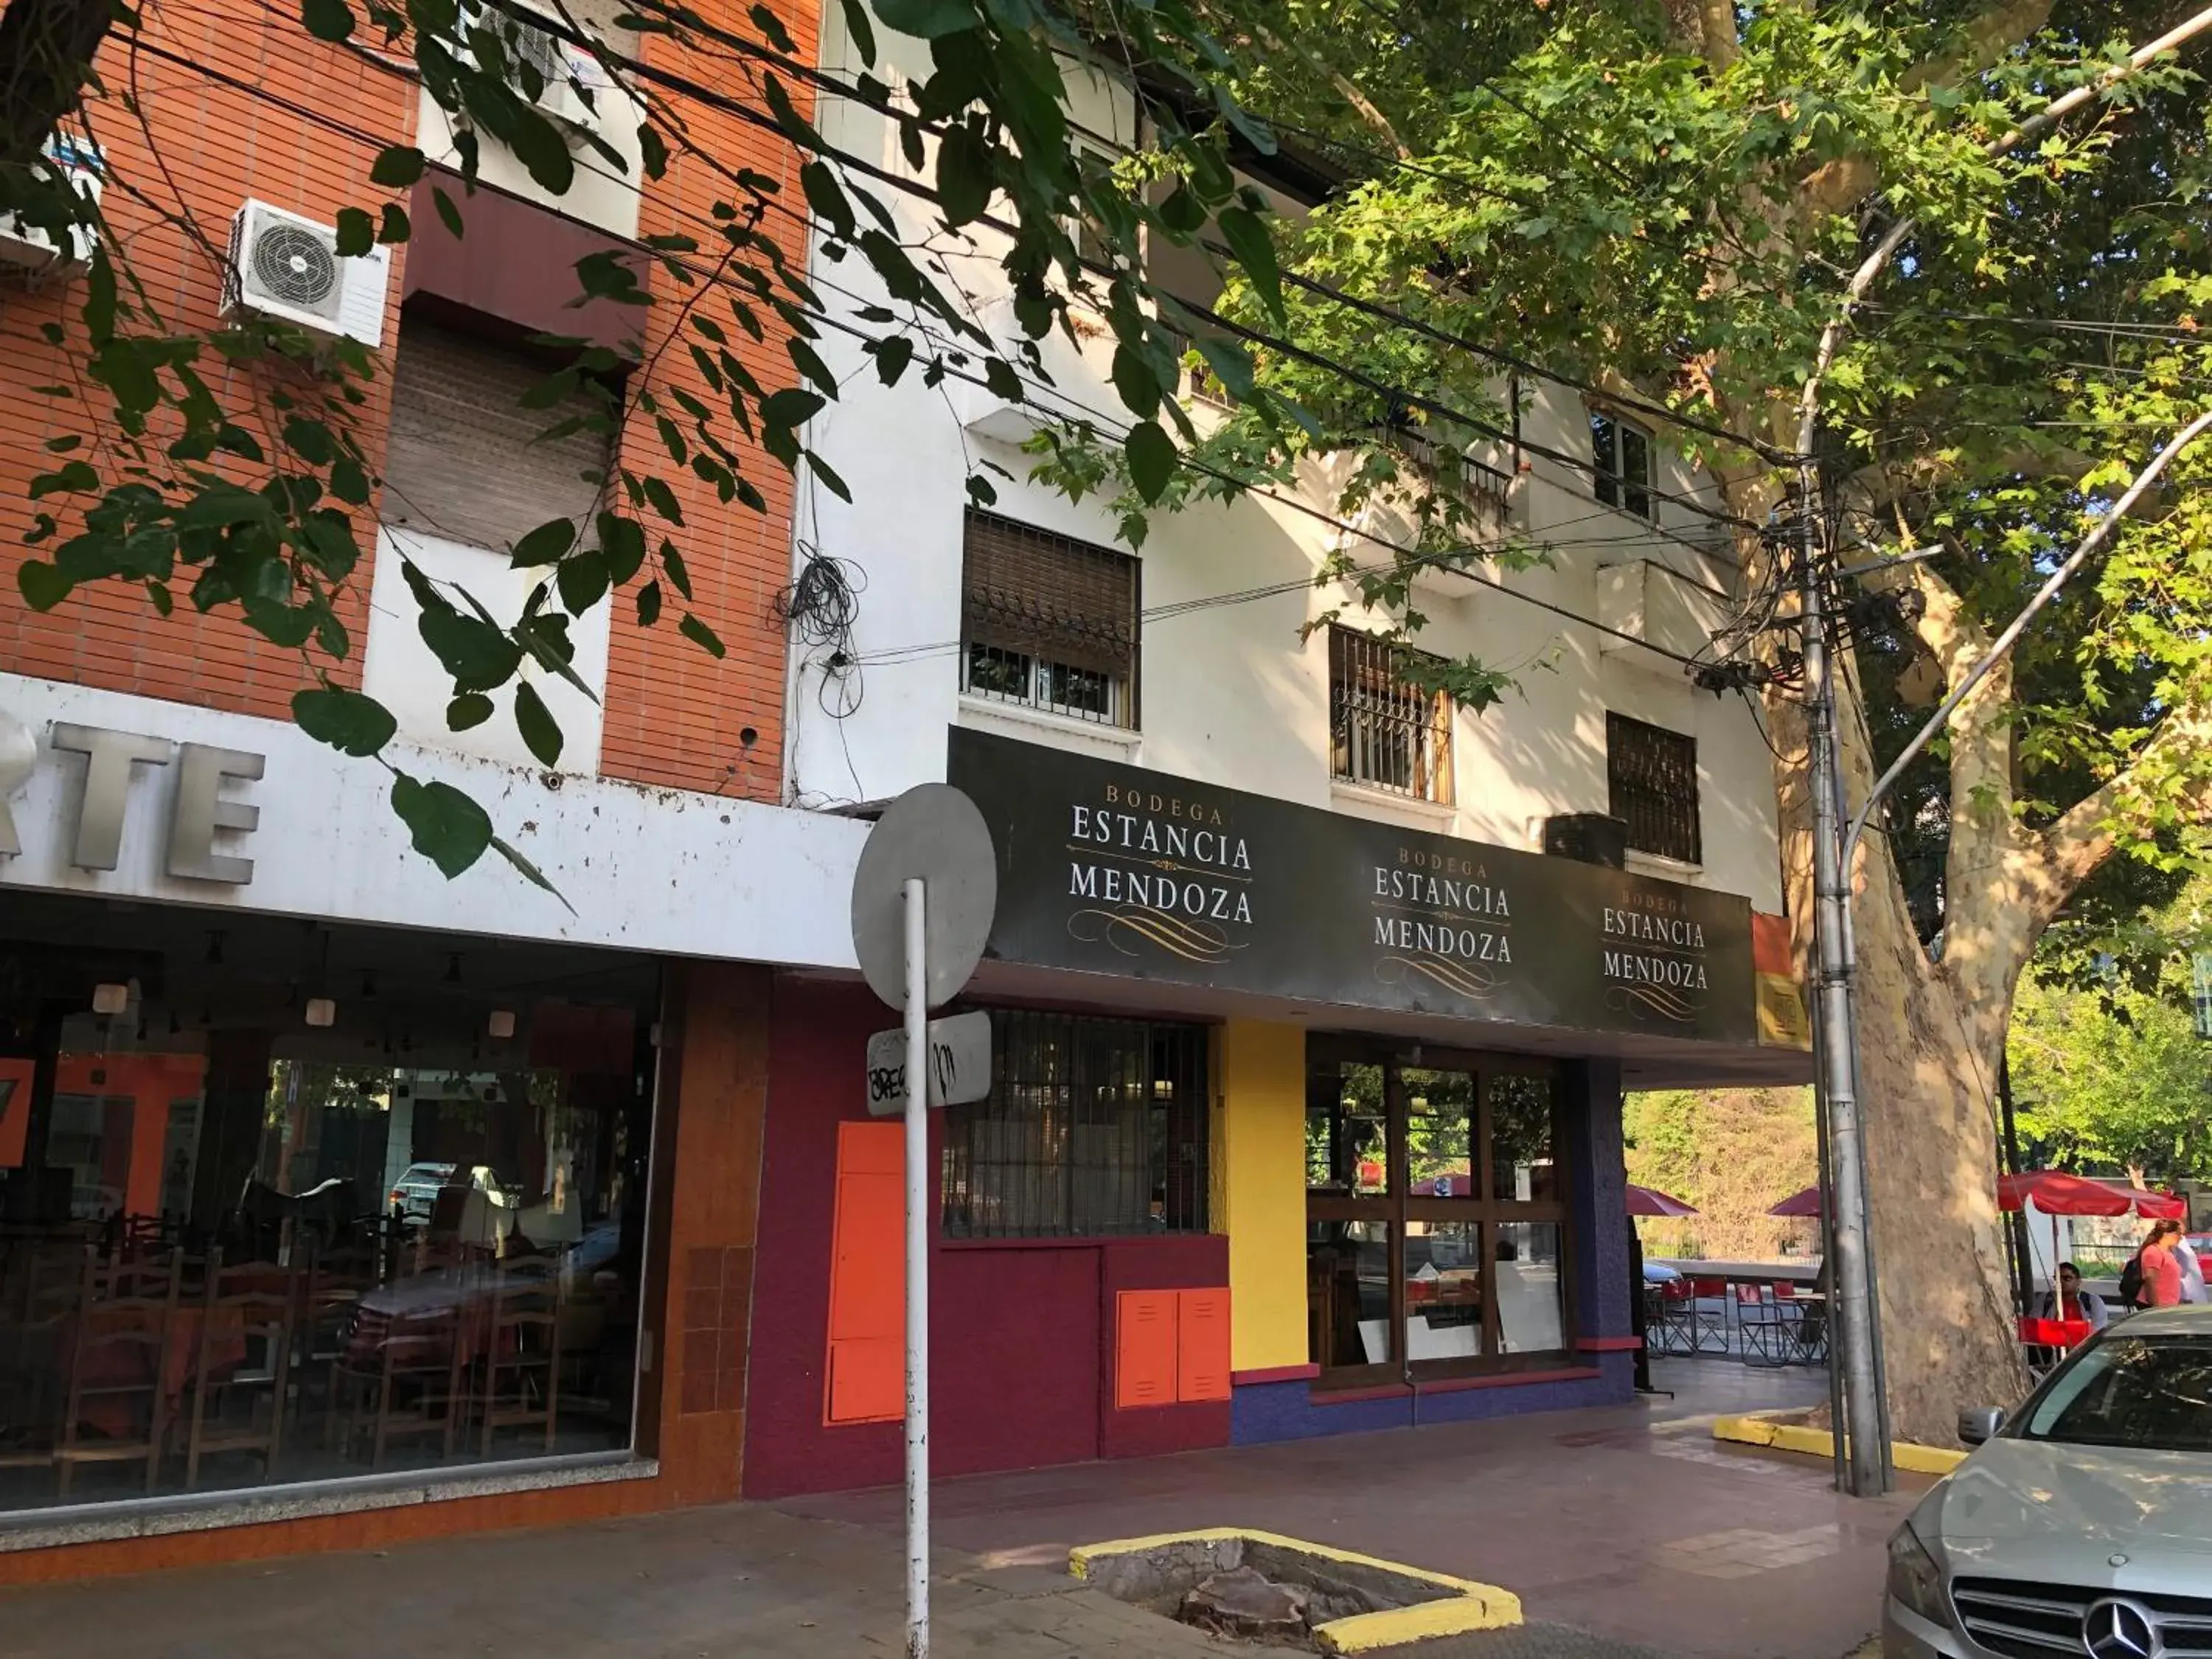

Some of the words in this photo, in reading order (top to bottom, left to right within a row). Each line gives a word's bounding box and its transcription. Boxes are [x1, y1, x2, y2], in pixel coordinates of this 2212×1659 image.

[1105, 785, 1222, 826] BODEGA
[1071, 805, 1252, 871] ESTANCIA
[1398, 846, 1488, 878] BODEGA
[1068, 862, 1253, 925] MENDOZA
[1374, 866, 1511, 917] ESTANCIA
[1621, 891, 1689, 915] BODEGA
[1374, 916, 1513, 964] MENDOZA
[1604, 908, 1705, 948] ESTANCIA
[1604, 951, 1708, 990] MENDOZA
